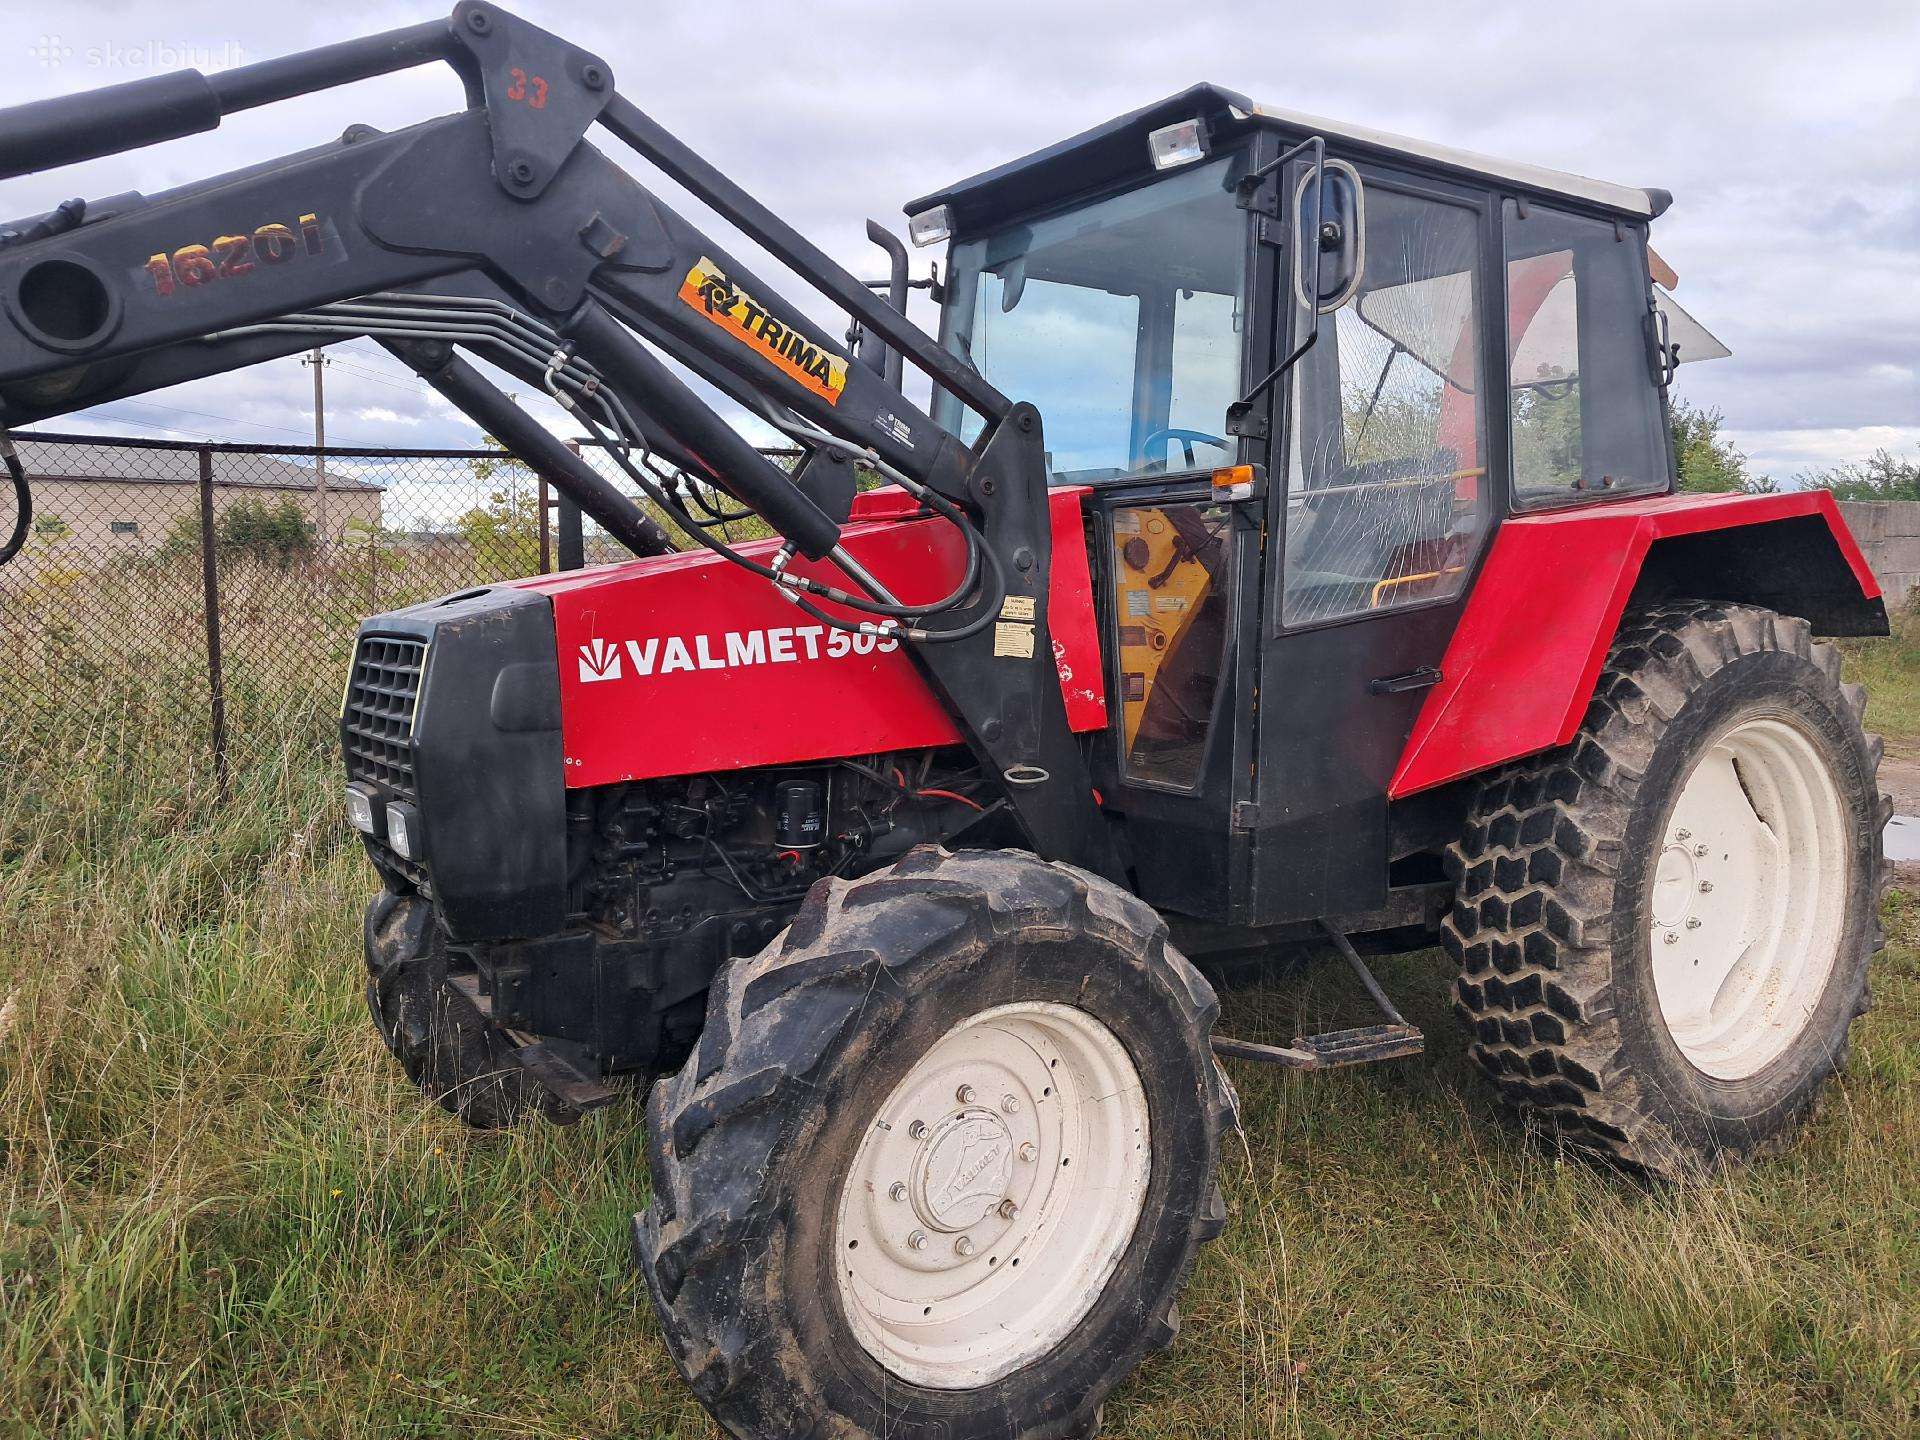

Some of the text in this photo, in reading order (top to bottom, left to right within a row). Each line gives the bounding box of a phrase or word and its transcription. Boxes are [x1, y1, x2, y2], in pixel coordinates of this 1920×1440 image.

[507, 67, 549, 109] 33
[144, 213, 324, 296] 1620i
[741, 301, 832, 388] TRIMA
[625, 625, 824, 676] VALMET
